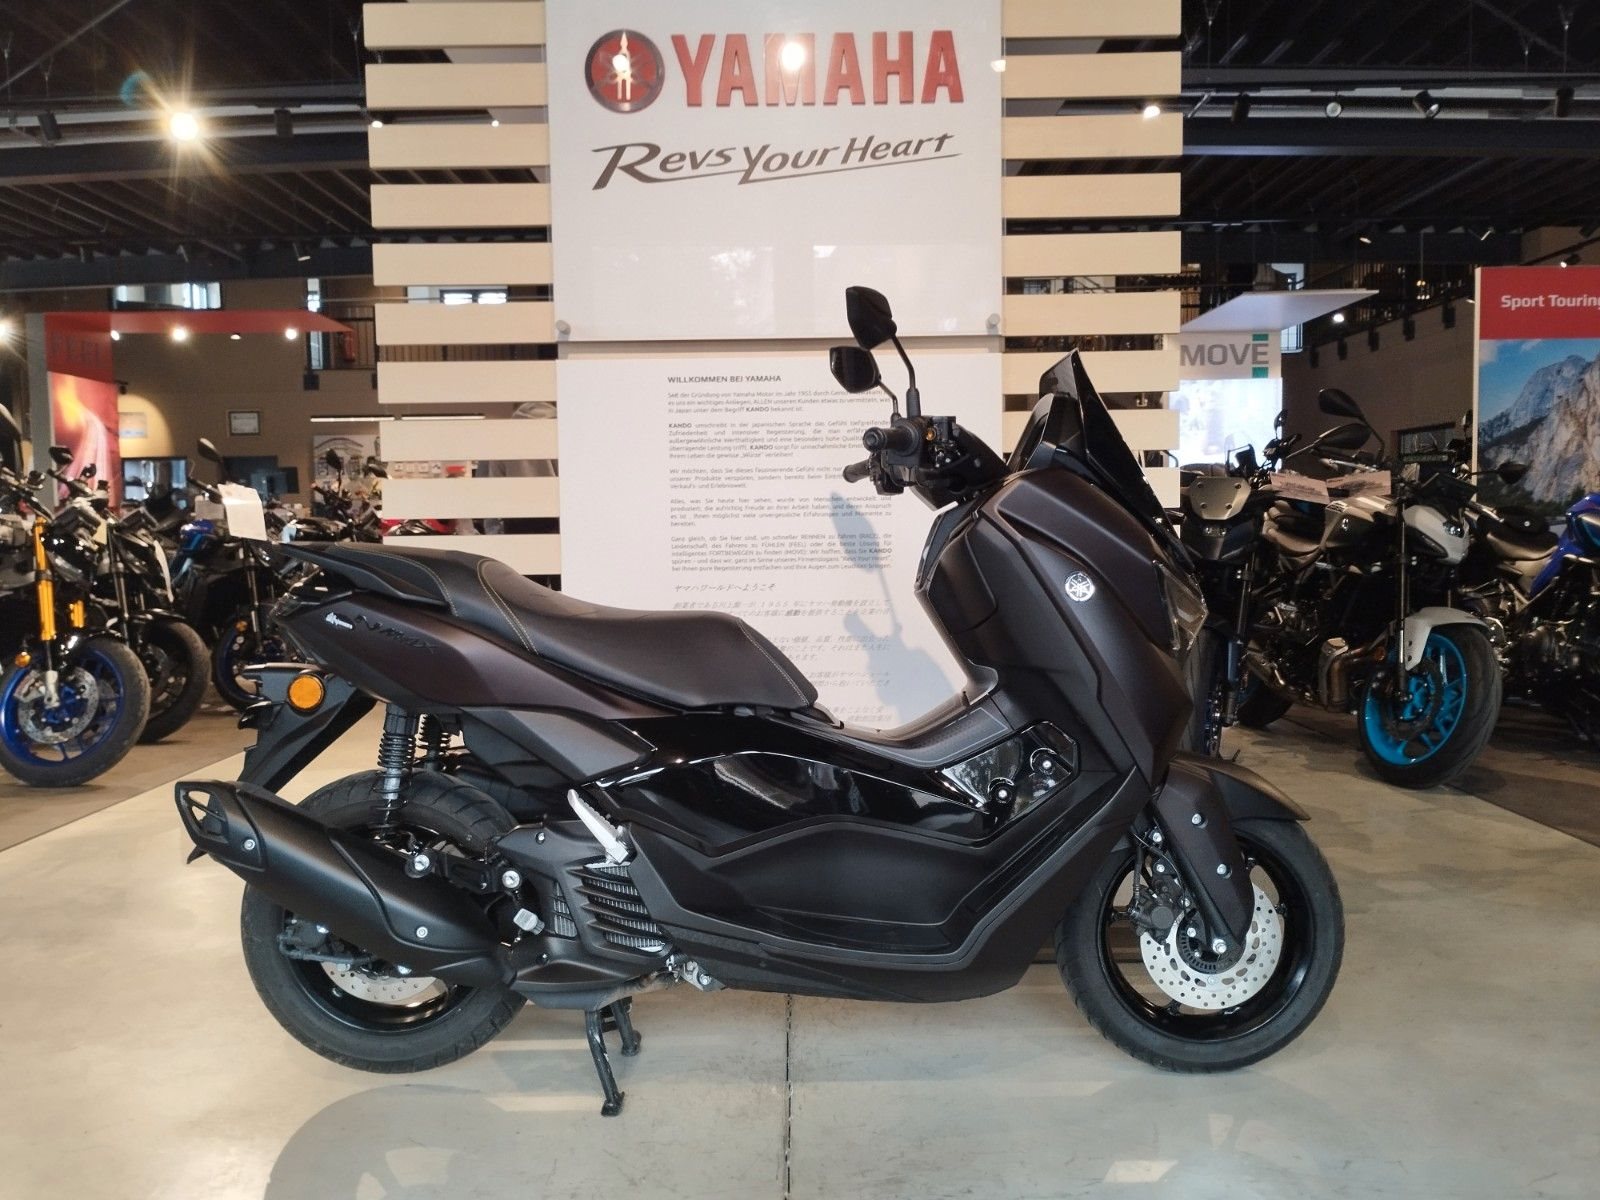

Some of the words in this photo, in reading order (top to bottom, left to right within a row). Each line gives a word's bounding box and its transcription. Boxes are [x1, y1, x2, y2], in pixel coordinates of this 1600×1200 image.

[670, 30, 965, 108] YAMAHA
[591, 141, 737, 191] Revs
[737, 143, 840, 186] Your
[841, 132, 955, 165] Heart
[1501, 294, 1545, 311] Sport
[1548, 294, 1600, 310] Tourin
[1179, 343, 1270, 366] MOVE
